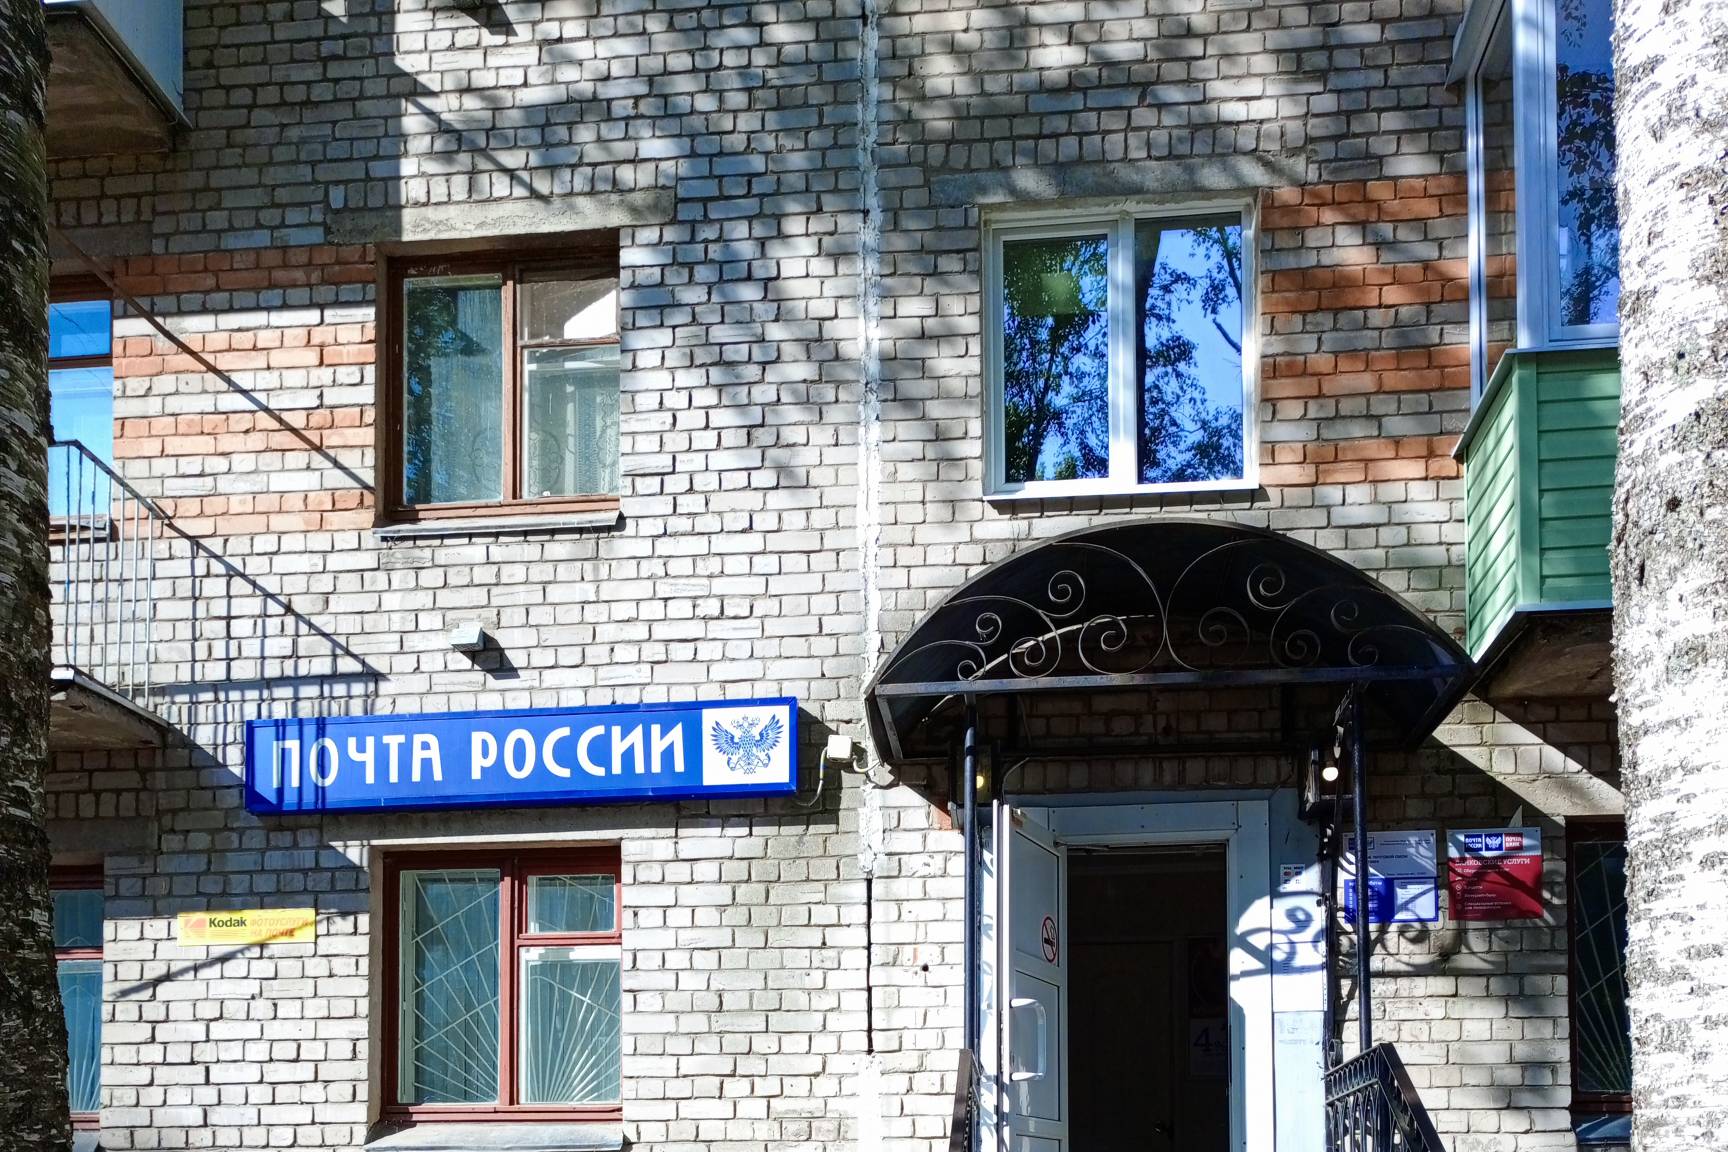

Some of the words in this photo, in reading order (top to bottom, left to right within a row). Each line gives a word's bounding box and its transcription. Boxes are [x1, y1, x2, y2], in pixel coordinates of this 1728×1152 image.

[273, 733, 443, 788] ПОЧТА
[471, 721, 685, 780] РОССИИ
[1503, 857, 1531, 865] УСЛУГИ
[209, 916, 247, 928] Kodak
